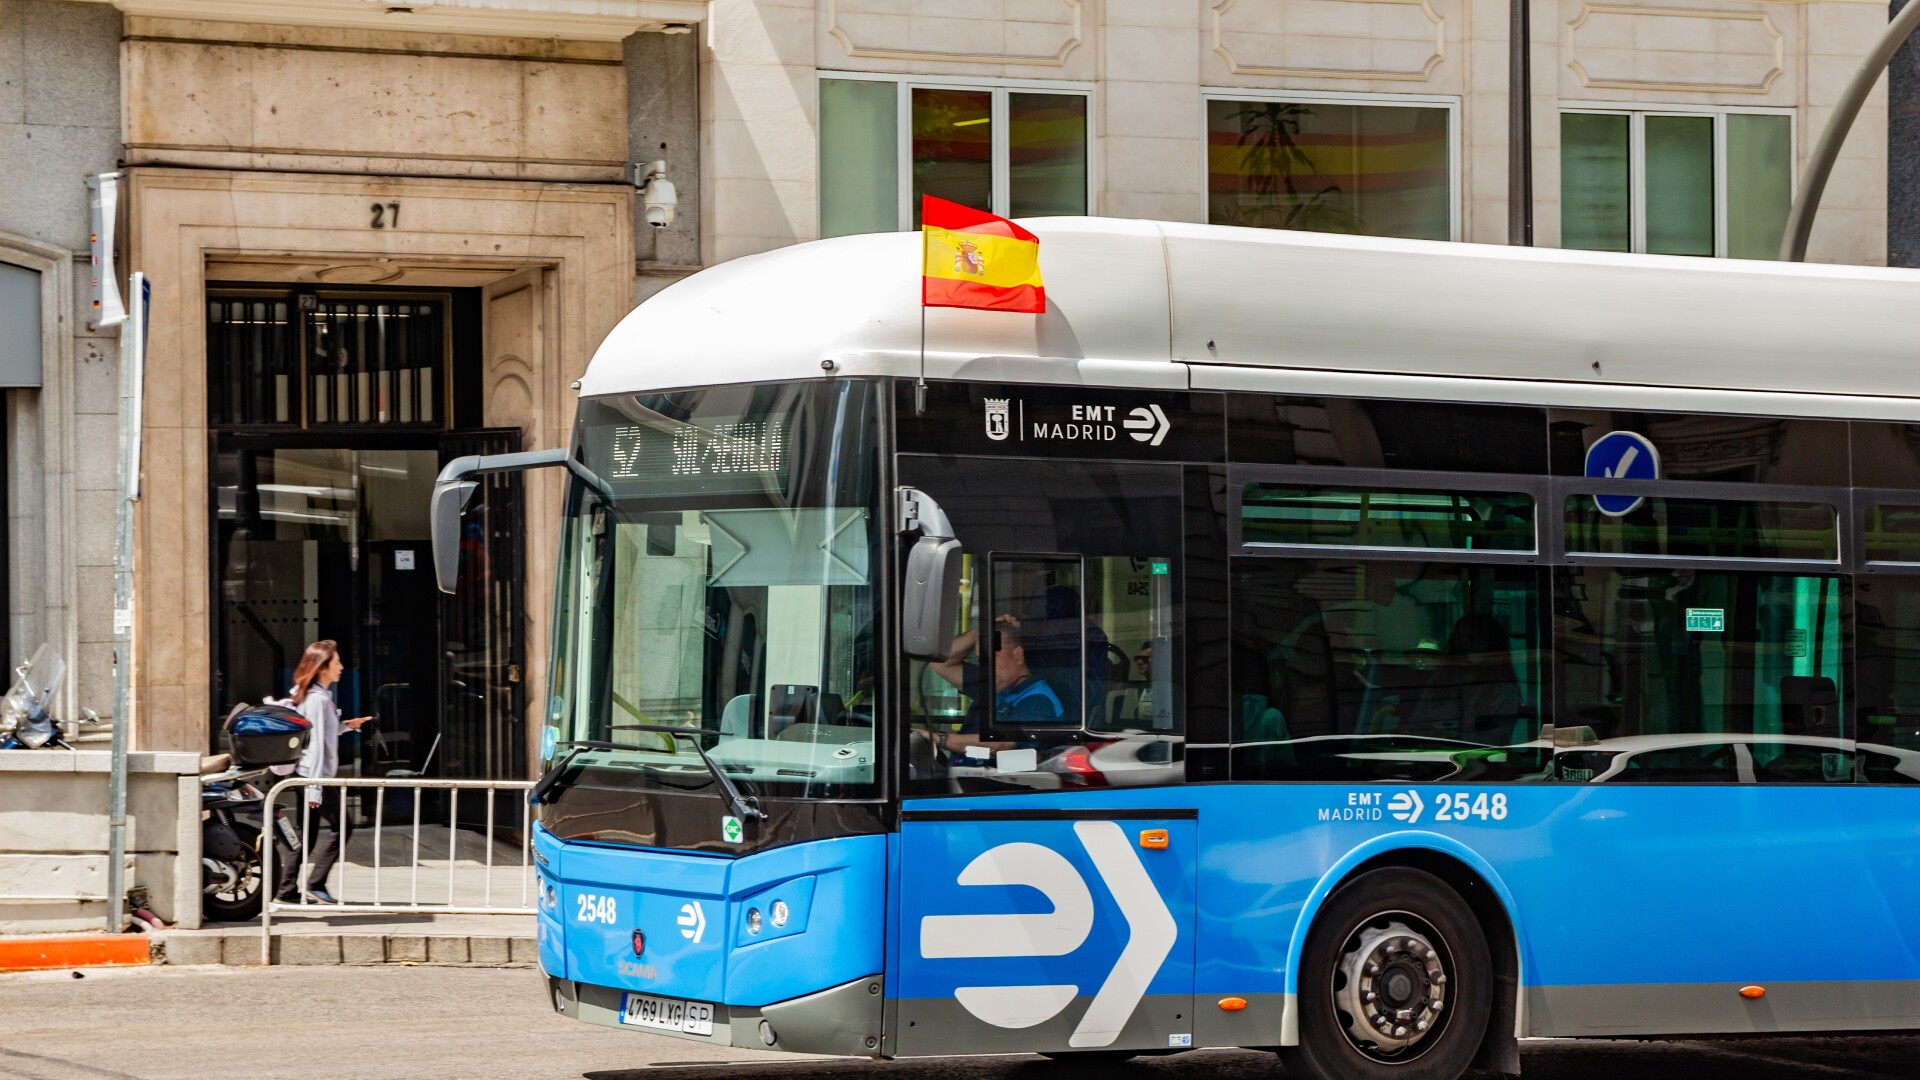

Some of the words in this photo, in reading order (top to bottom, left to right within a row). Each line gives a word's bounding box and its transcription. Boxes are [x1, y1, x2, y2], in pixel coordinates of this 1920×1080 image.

[370, 202, 400, 229] 27
[1072, 404, 1116, 422] EMT
[1033, 422, 1116, 441] MADRID
[612, 426, 641, 477] 52
[1348, 792, 1382, 805] EMT
[1435, 793, 1507, 820] 2548
[1318, 808, 1382, 820] MADRID
[577, 893, 616, 924] 2548
[628, 998, 656, 1022] 4769
[659, 1002, 682, 1026] LXG
[689, 1006, 709, 1030] SP
